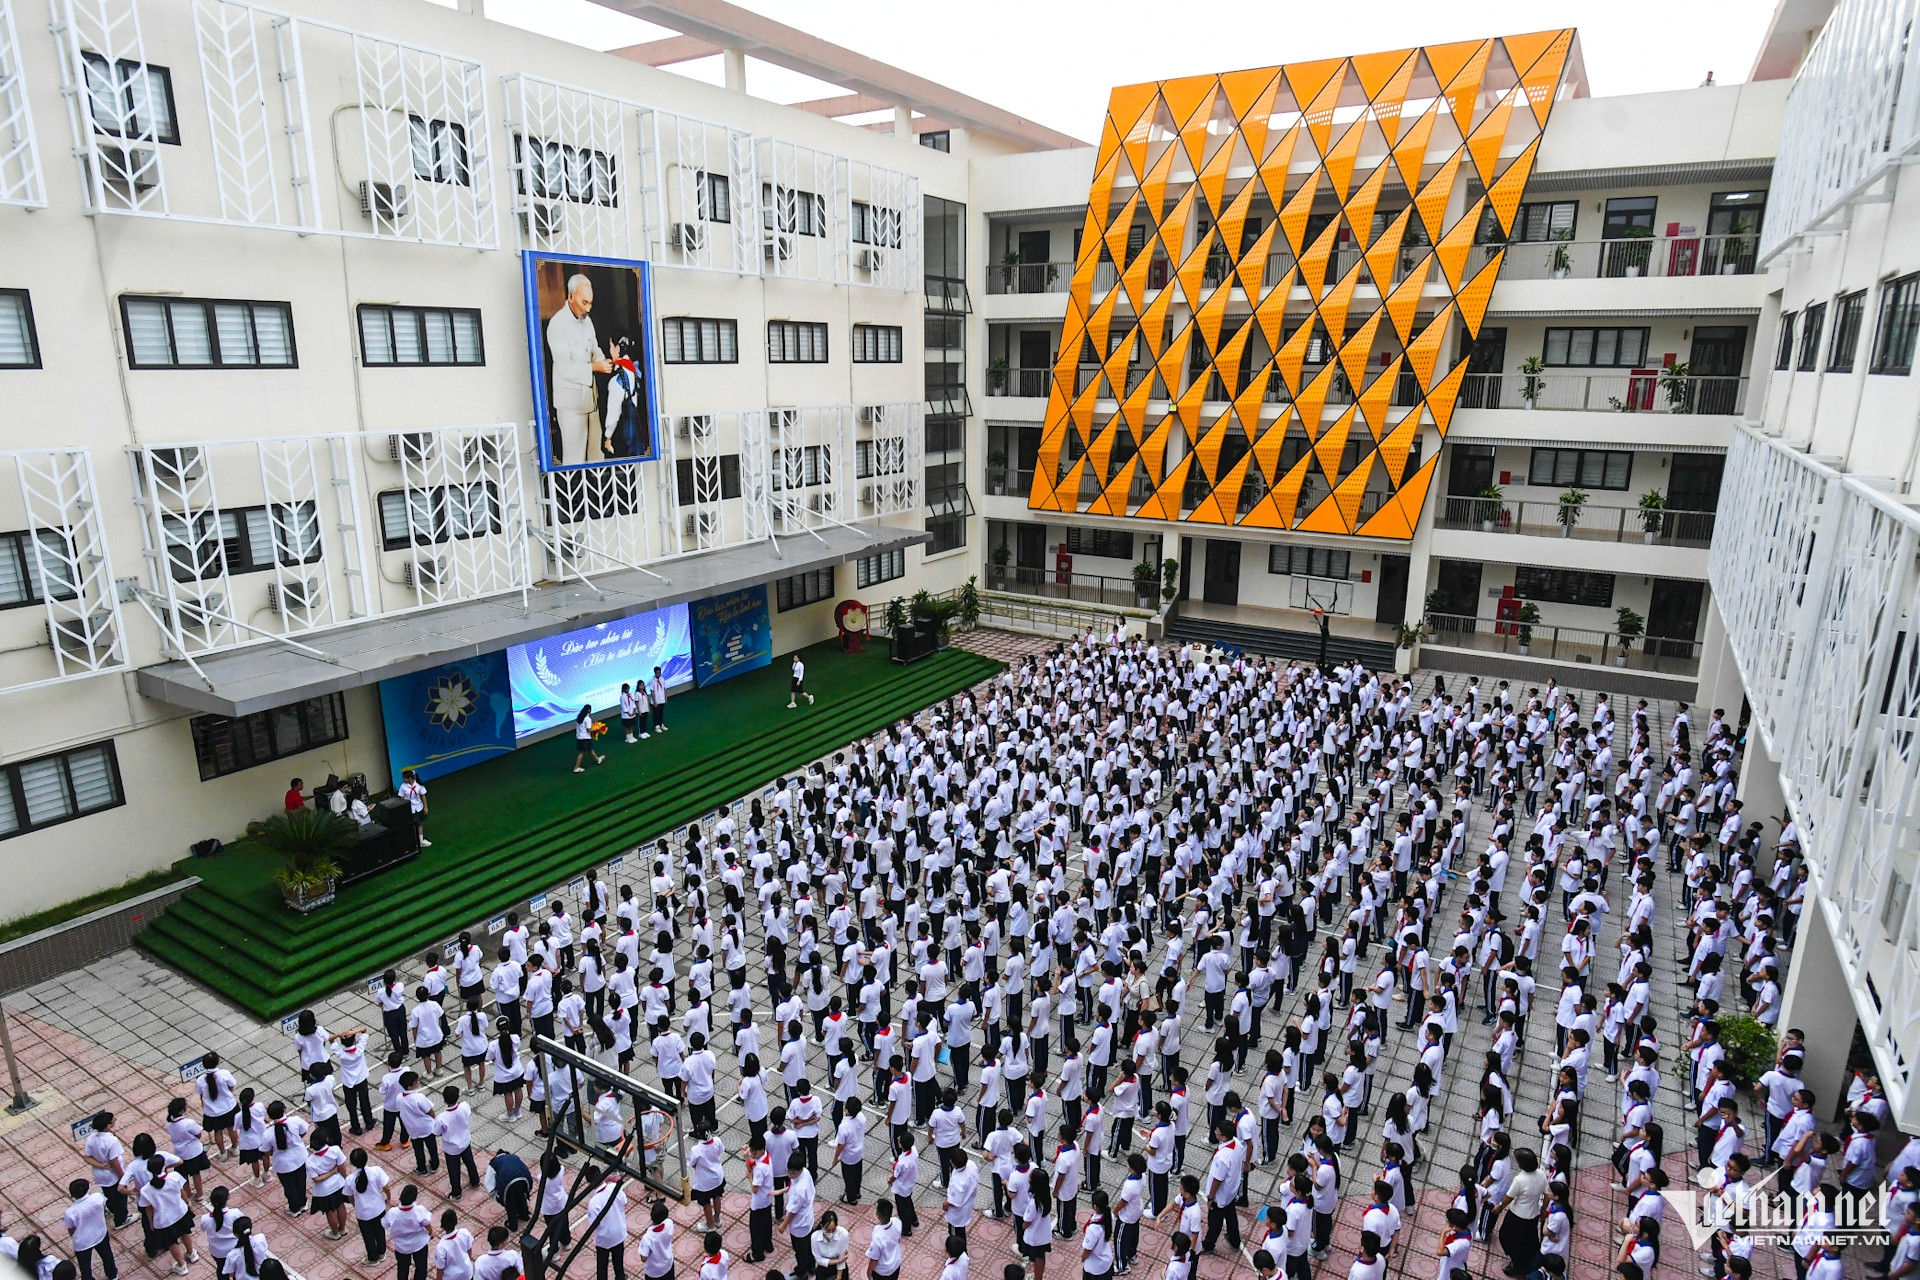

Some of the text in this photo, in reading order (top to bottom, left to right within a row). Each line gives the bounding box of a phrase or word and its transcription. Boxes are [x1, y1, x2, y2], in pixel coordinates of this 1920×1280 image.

[491, 920, 504, 932] 6A7
[371, 982, 383, 991] 6A
[286, 1021, 299, 1032] 6A
[79, 1124, 94, 1136] 6A
